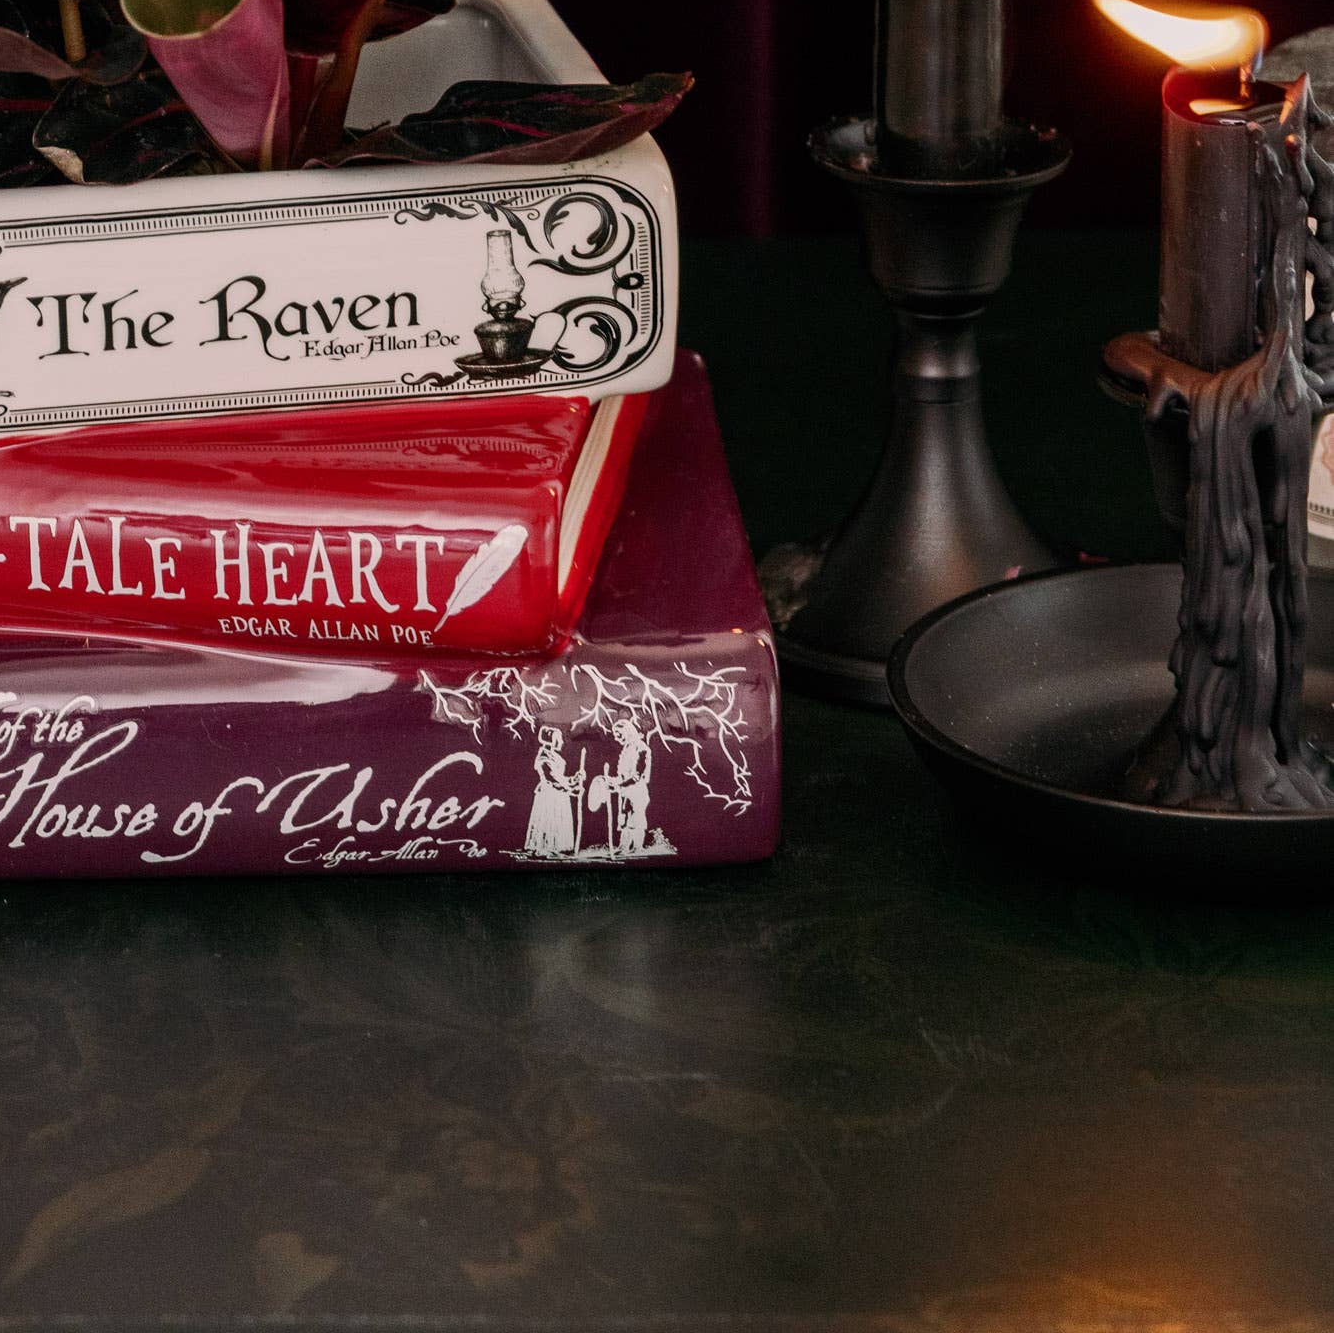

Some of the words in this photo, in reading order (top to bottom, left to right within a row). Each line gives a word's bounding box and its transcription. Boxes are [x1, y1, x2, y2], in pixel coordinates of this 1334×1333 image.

[27, 288, 175, 360] The
[198, 274, 421, 361] Raven
[299, 336, 364, 360] Edgar
[360, 333, 417, 359] Allan
[420, 329, 461, 349] Poe
[210, 519, 445, 614] HEART
[218, 615, 297, 638] EDGAR
[308, 618, 379, 641] ALLAN
[391, 624, 434, 646] POE
[33, 695, 95, 744] the
[139, 776, 266, 863] of
[258, 751, 504, 837] Usher
[284, 836, 371, 868] Edgar
[367, 836, 438, 862] Allan
